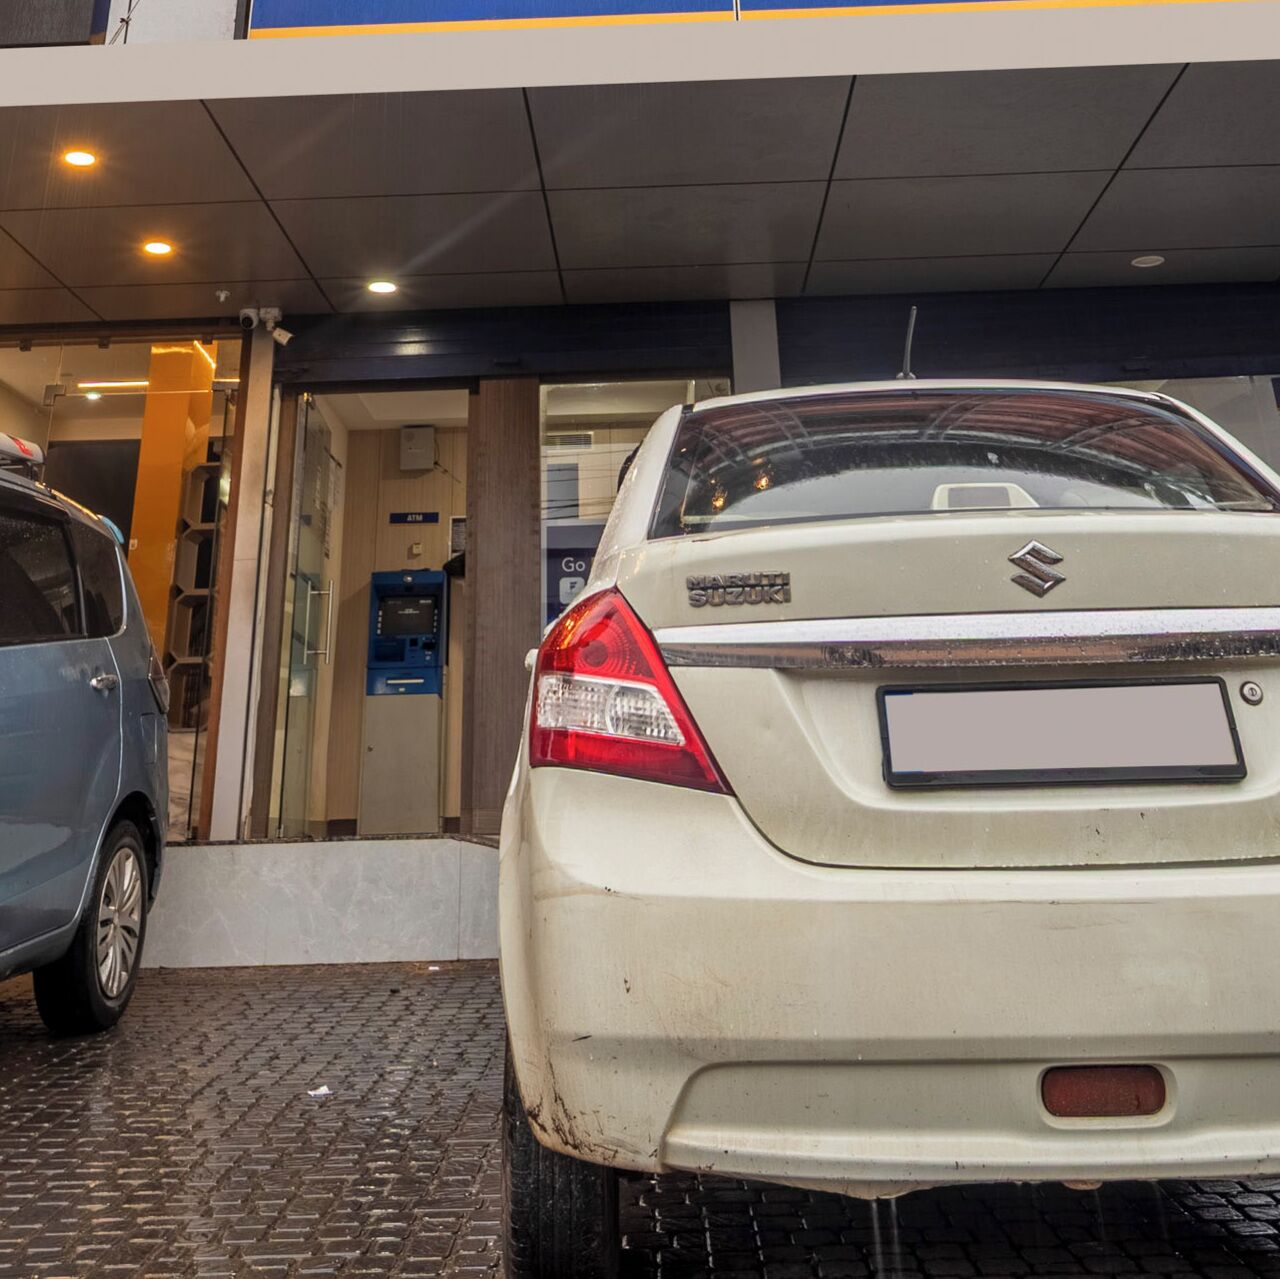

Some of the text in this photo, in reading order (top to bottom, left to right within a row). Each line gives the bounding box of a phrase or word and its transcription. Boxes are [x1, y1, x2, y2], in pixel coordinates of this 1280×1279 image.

[406, 513, 424, 522] ATM
[561, 557, 586, 572] Go
[686, 572, 790, 589] MARUTI
[688, 586, 792, 608] SUZUKI
